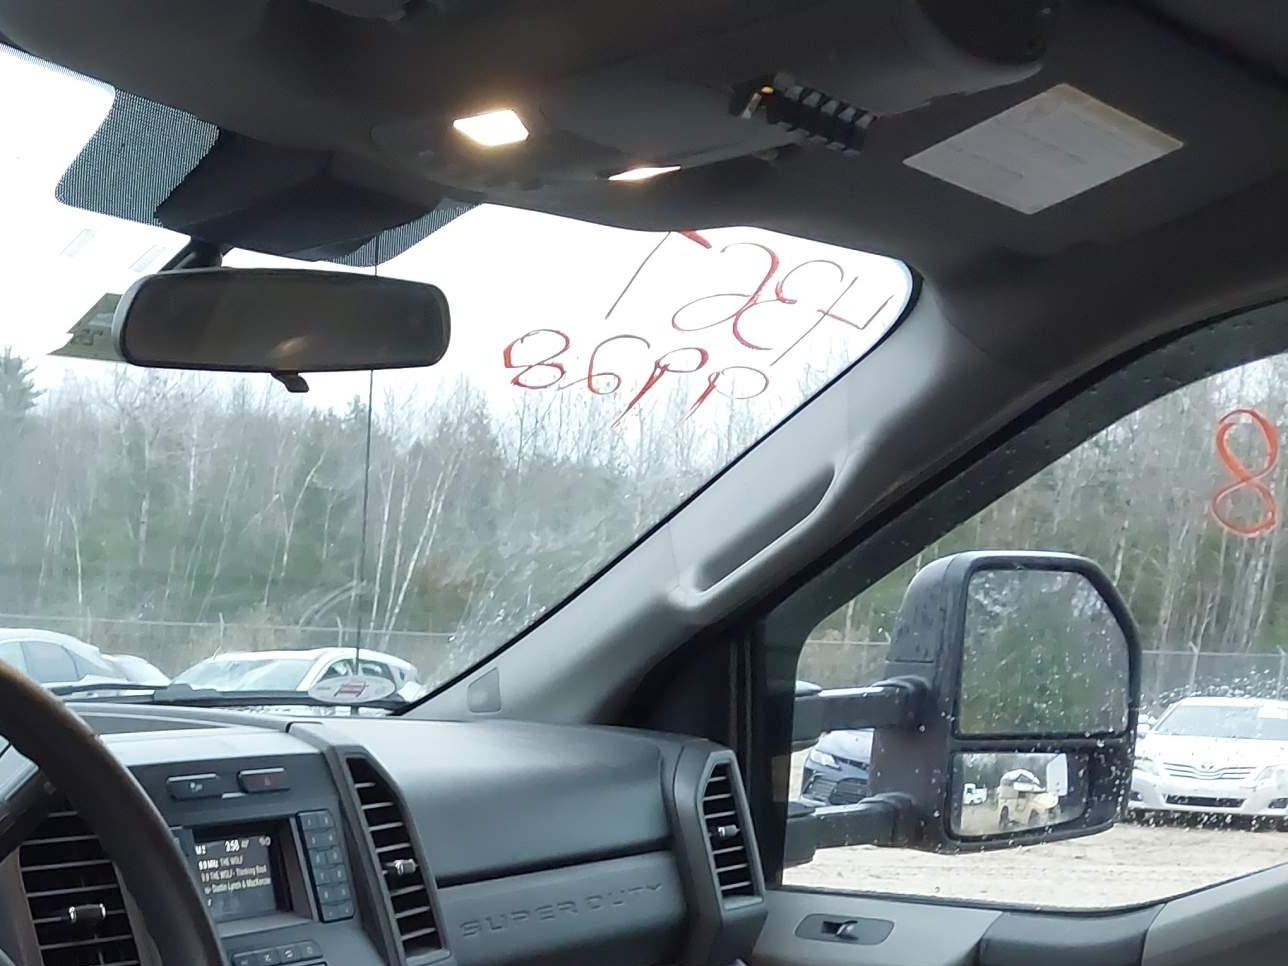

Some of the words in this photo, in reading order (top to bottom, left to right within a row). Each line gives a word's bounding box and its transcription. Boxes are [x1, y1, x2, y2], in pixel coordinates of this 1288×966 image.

[1210, 408, 1280, 538] 8
[459, 900, 579, 937] SUPER
[585, 883, 663, 910] DUTY
